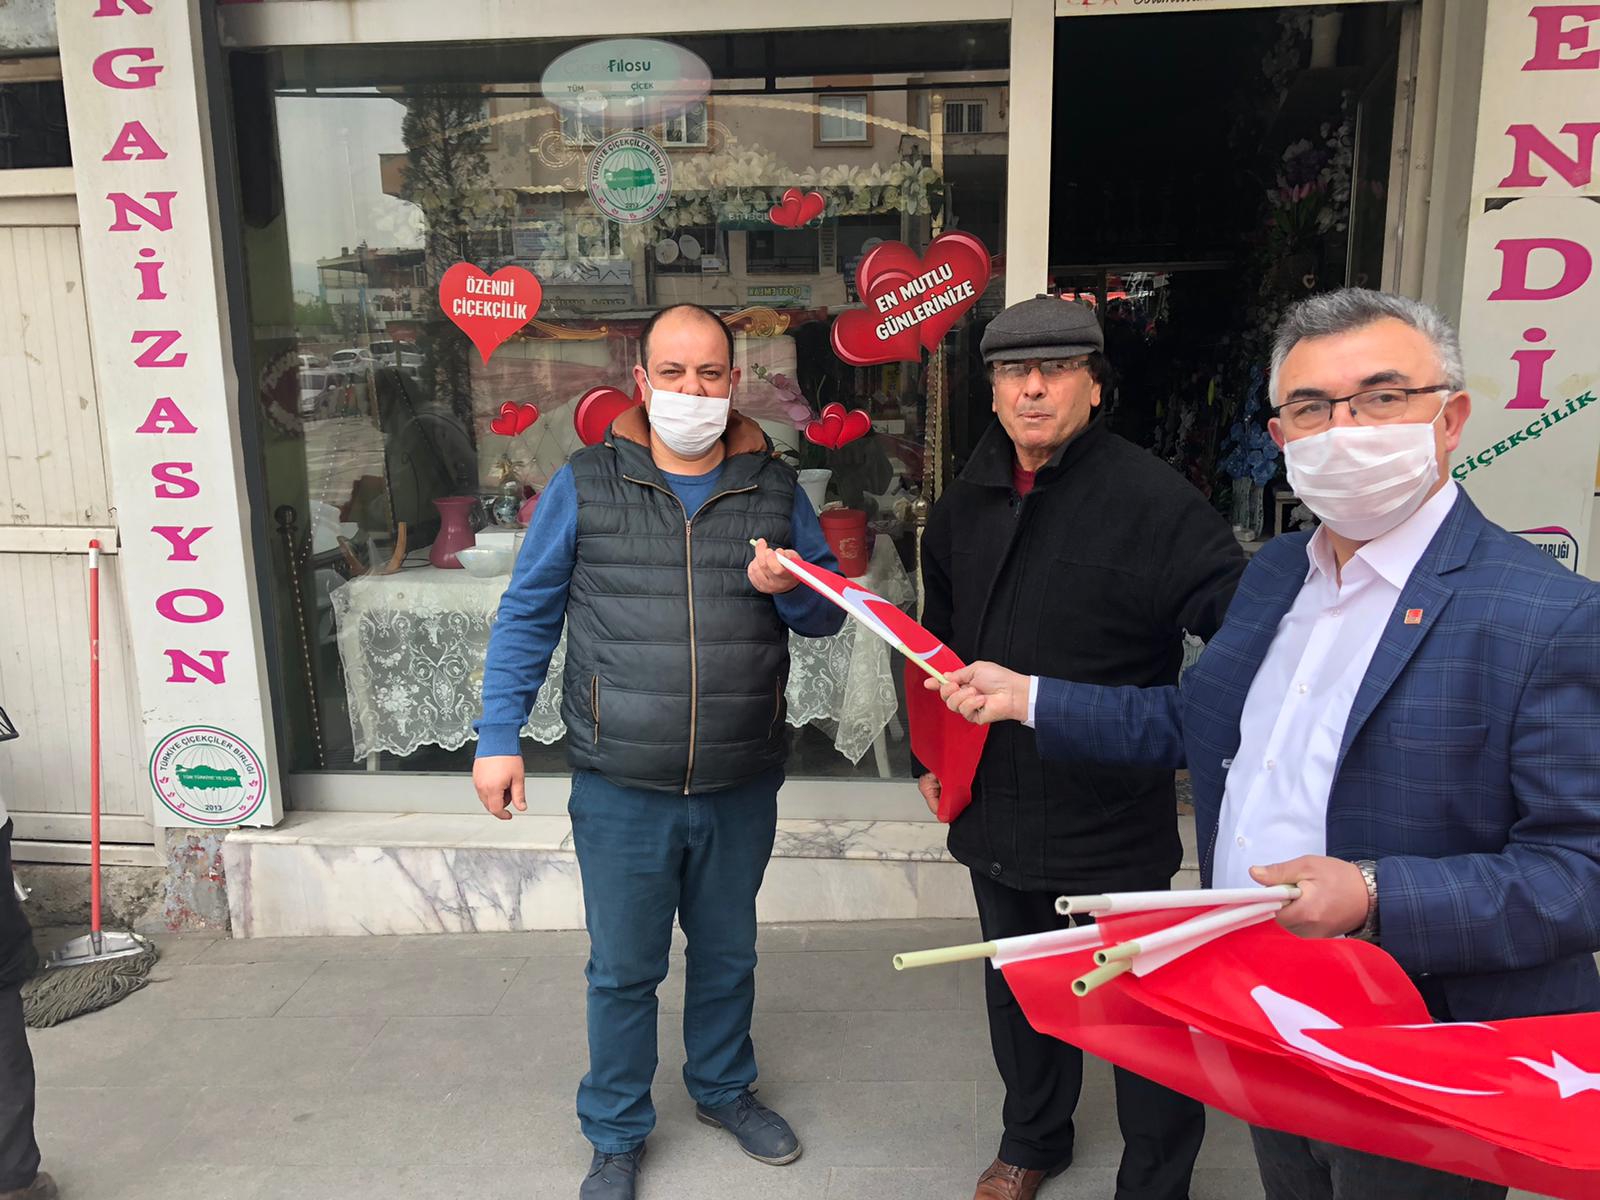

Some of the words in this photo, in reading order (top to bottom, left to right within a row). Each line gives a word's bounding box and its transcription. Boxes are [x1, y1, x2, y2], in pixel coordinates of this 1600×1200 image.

[592, 149, 609, 180] TÜRKİYE
[466, 275, 515, 297] ÖZENDİ
[875, 291, 899, 314] EN
[899, 263, 953, 302] MUTLU
[452, 297, 527, 320] ÇİÇEKÇİLİK
[875, 280, 976, 341] GÜNLERİNİZE
[1451, 390, 1598, 482] ÇİÇEKÇİLİK
[160, 743, 181, 771] TÜRKİYE
[181, 735, 233, 749] ÇİÇEKÇİLER
[233, 748, 256, 775] BİRLİĞİ
